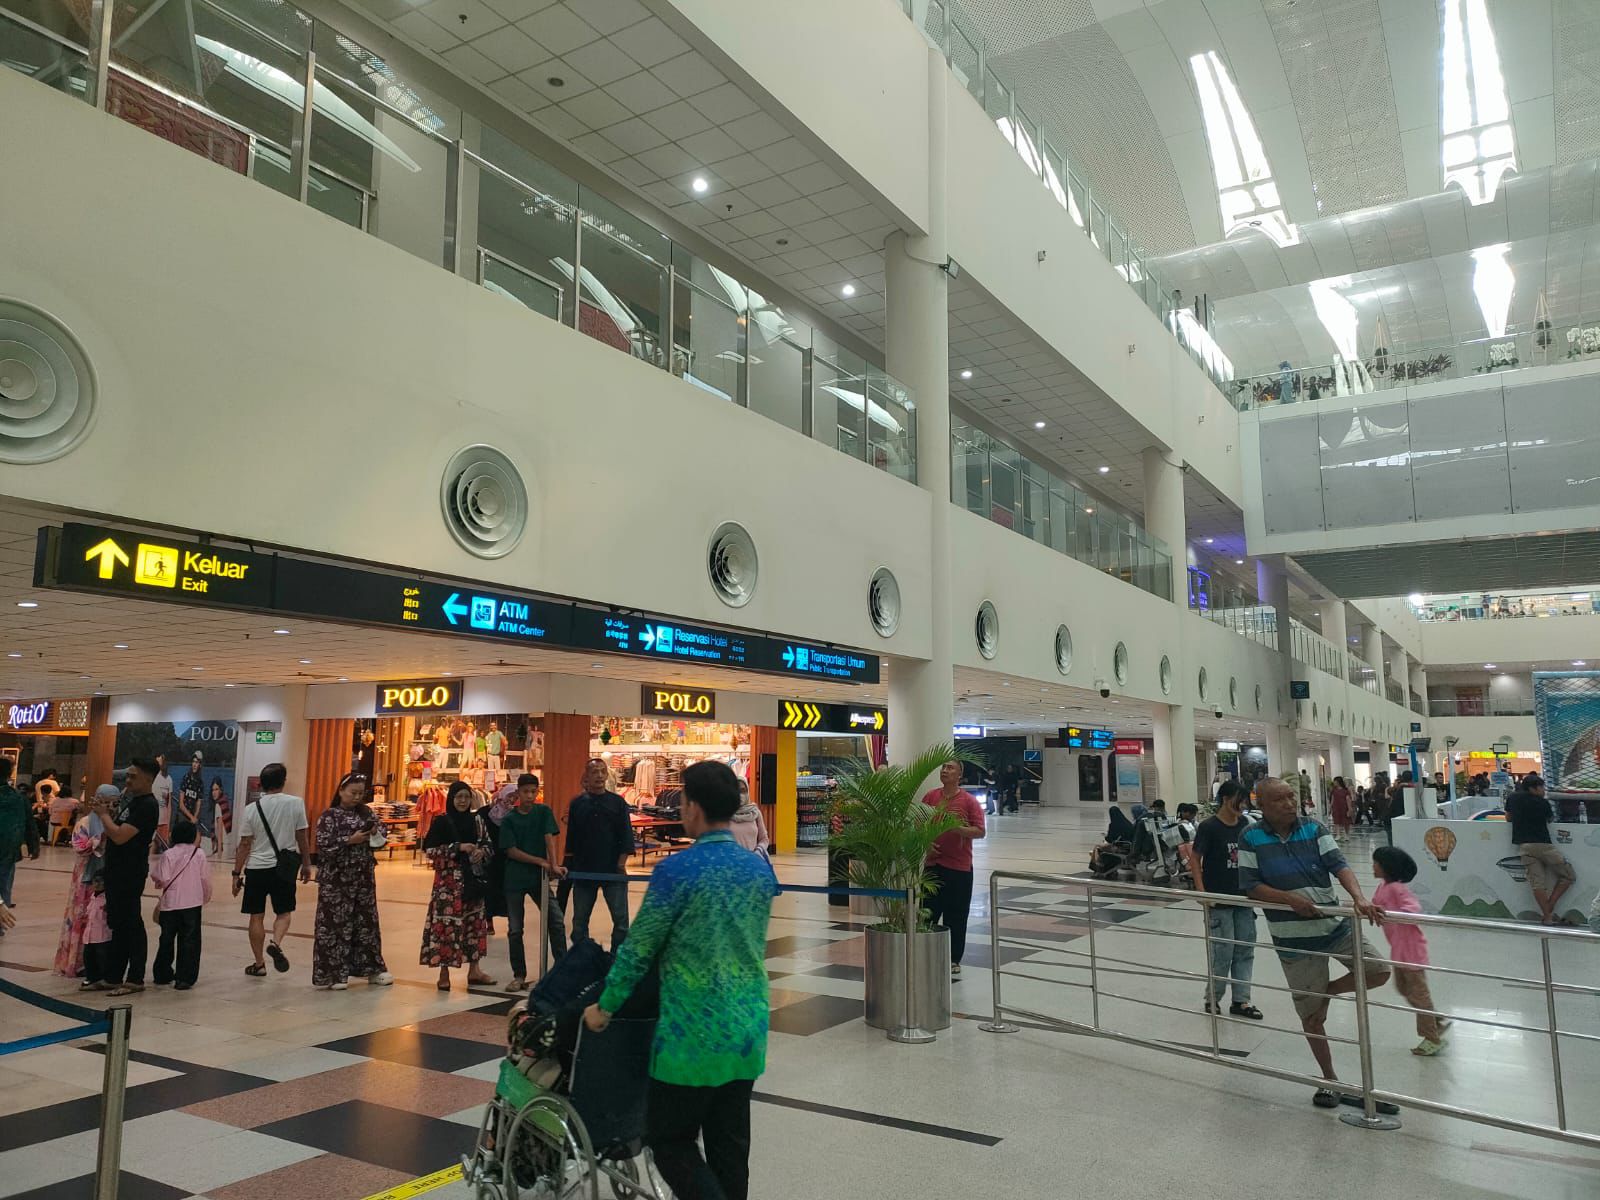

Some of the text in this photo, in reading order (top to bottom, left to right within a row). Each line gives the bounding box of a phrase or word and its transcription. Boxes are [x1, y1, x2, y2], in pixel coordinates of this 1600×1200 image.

[183, 551, 249, 579] Keluar
[182, 577, 209, 593] Exit
[499, 601, 529, 621] ATM
[498, 621, 546, 637] ATM Center
[674, 628, 729, 648] Reservasi Hotel
[674, 644, 690, 656] Hotel
[689, 646, 721, 660] Reservation
[810, 649, 866, 670] Transportasi Umum
[382, 686, 450, 708] POLO
[654, 691, 711, 714] POLO
[189, 725, 238, 742] POLO
